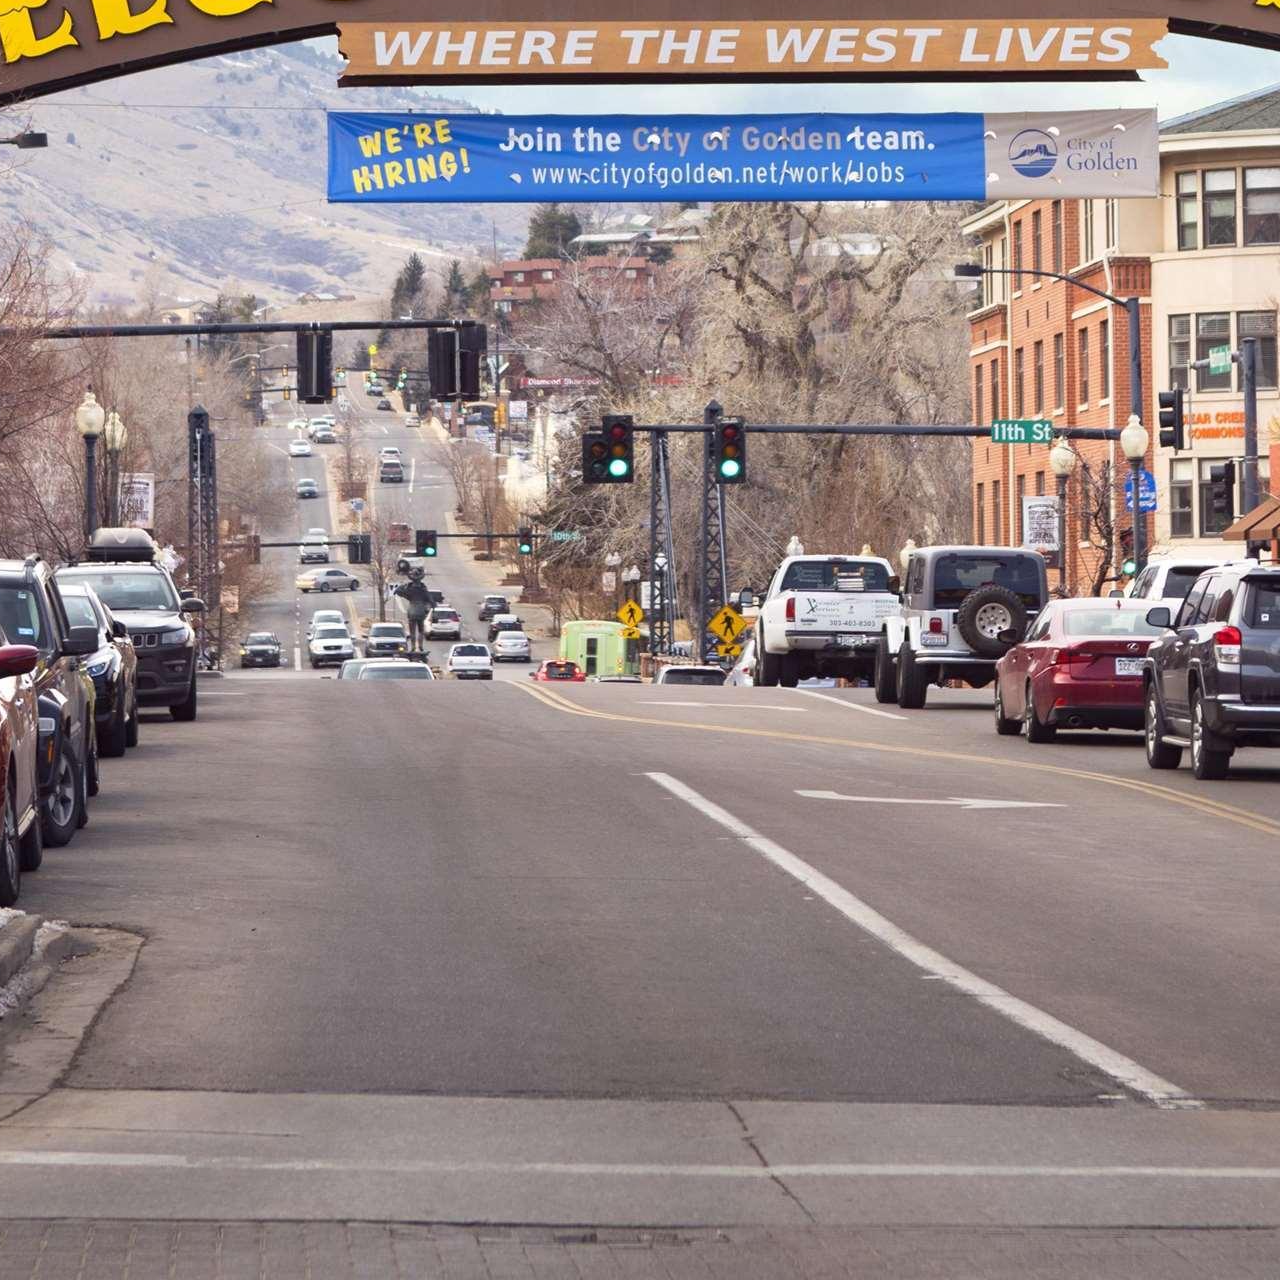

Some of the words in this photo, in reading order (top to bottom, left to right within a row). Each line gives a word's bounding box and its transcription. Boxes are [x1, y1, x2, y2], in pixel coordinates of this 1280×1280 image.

[373, 30, 598, 66] WHERE
[620, 29, 740, 64] THE
[765, 28, 943, 64] WEST
[959, 27, 1133, 63] LIVES
[359, 119, 452, 158] WE'RE
[499, 127, 562, 153] Join
[572, 127, 621, 152] the
[632, 126, 689, 157] City
[702, 125, 730, 152] of
[742, 125, 842, 152] Golden
[853, 126, 936, 152] team.
[1067, 138, 1095, 152] City
[1100, 137, 1115, 149] of
[352, 148, 471, 194] HIRING!
[1067, 152, 1138, 171] Golden
[993, 423, 1025, 440] 11th
[1032, 423, 1051, 440] St
